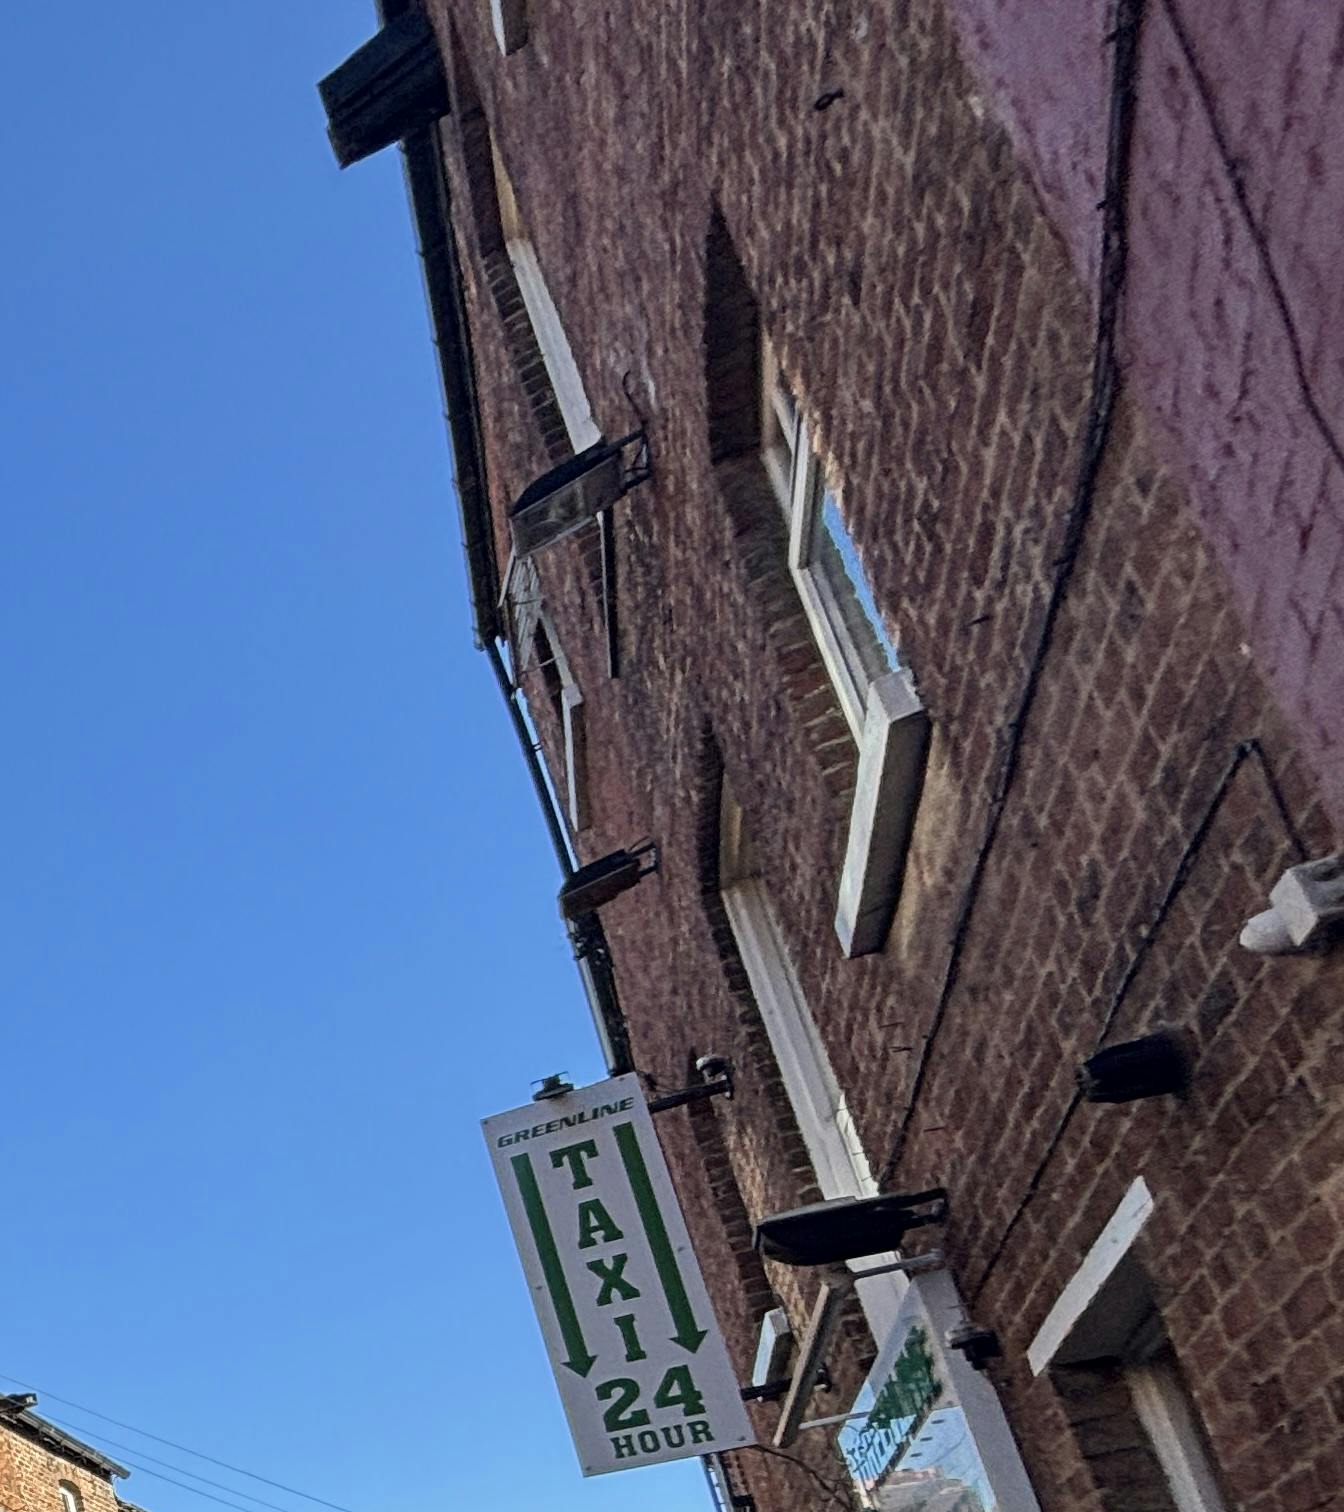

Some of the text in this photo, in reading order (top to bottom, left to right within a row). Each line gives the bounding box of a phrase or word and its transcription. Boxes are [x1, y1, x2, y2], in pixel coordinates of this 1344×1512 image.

[497, 1097, 635, 1148] GREENLINE
[550, 1138, 647, 1362] TAXI
[595, 1365, 706, 1432] 24
[610, 1421, 715, 1459] HOUR
